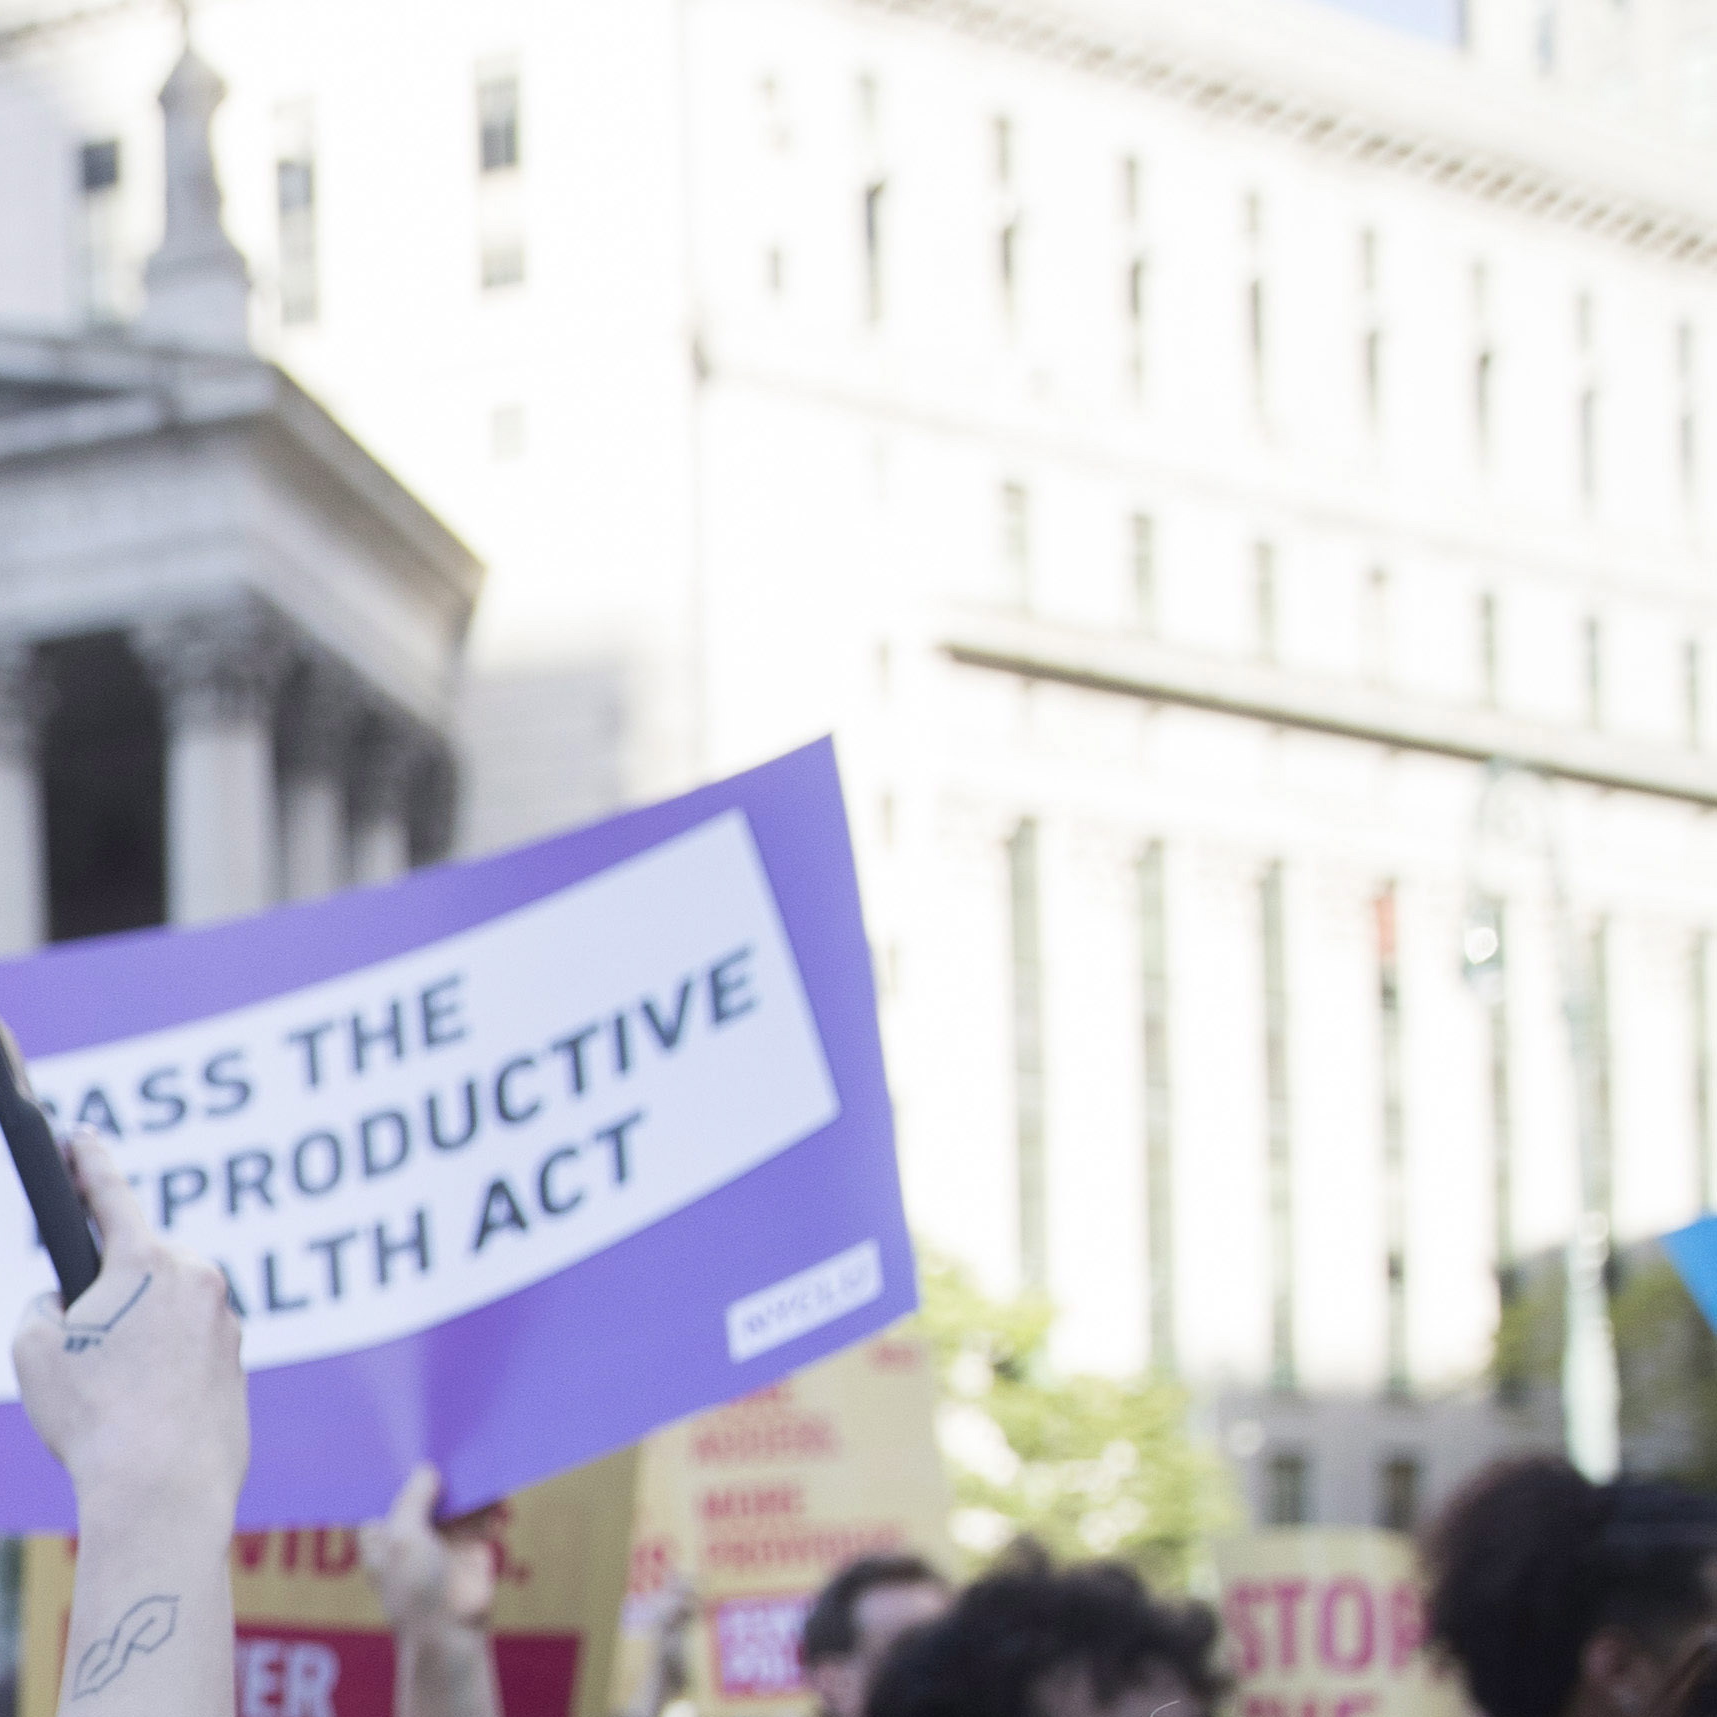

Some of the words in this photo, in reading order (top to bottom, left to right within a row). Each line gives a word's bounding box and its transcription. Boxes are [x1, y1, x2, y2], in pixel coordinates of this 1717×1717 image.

[128, 942, 762, 1228] PRODUCTIVE
[286, 971, 471, 1093] THE
[465, 1110, 650, 1254] ACT
[1225, 1577, 1434, 1677] STOP
